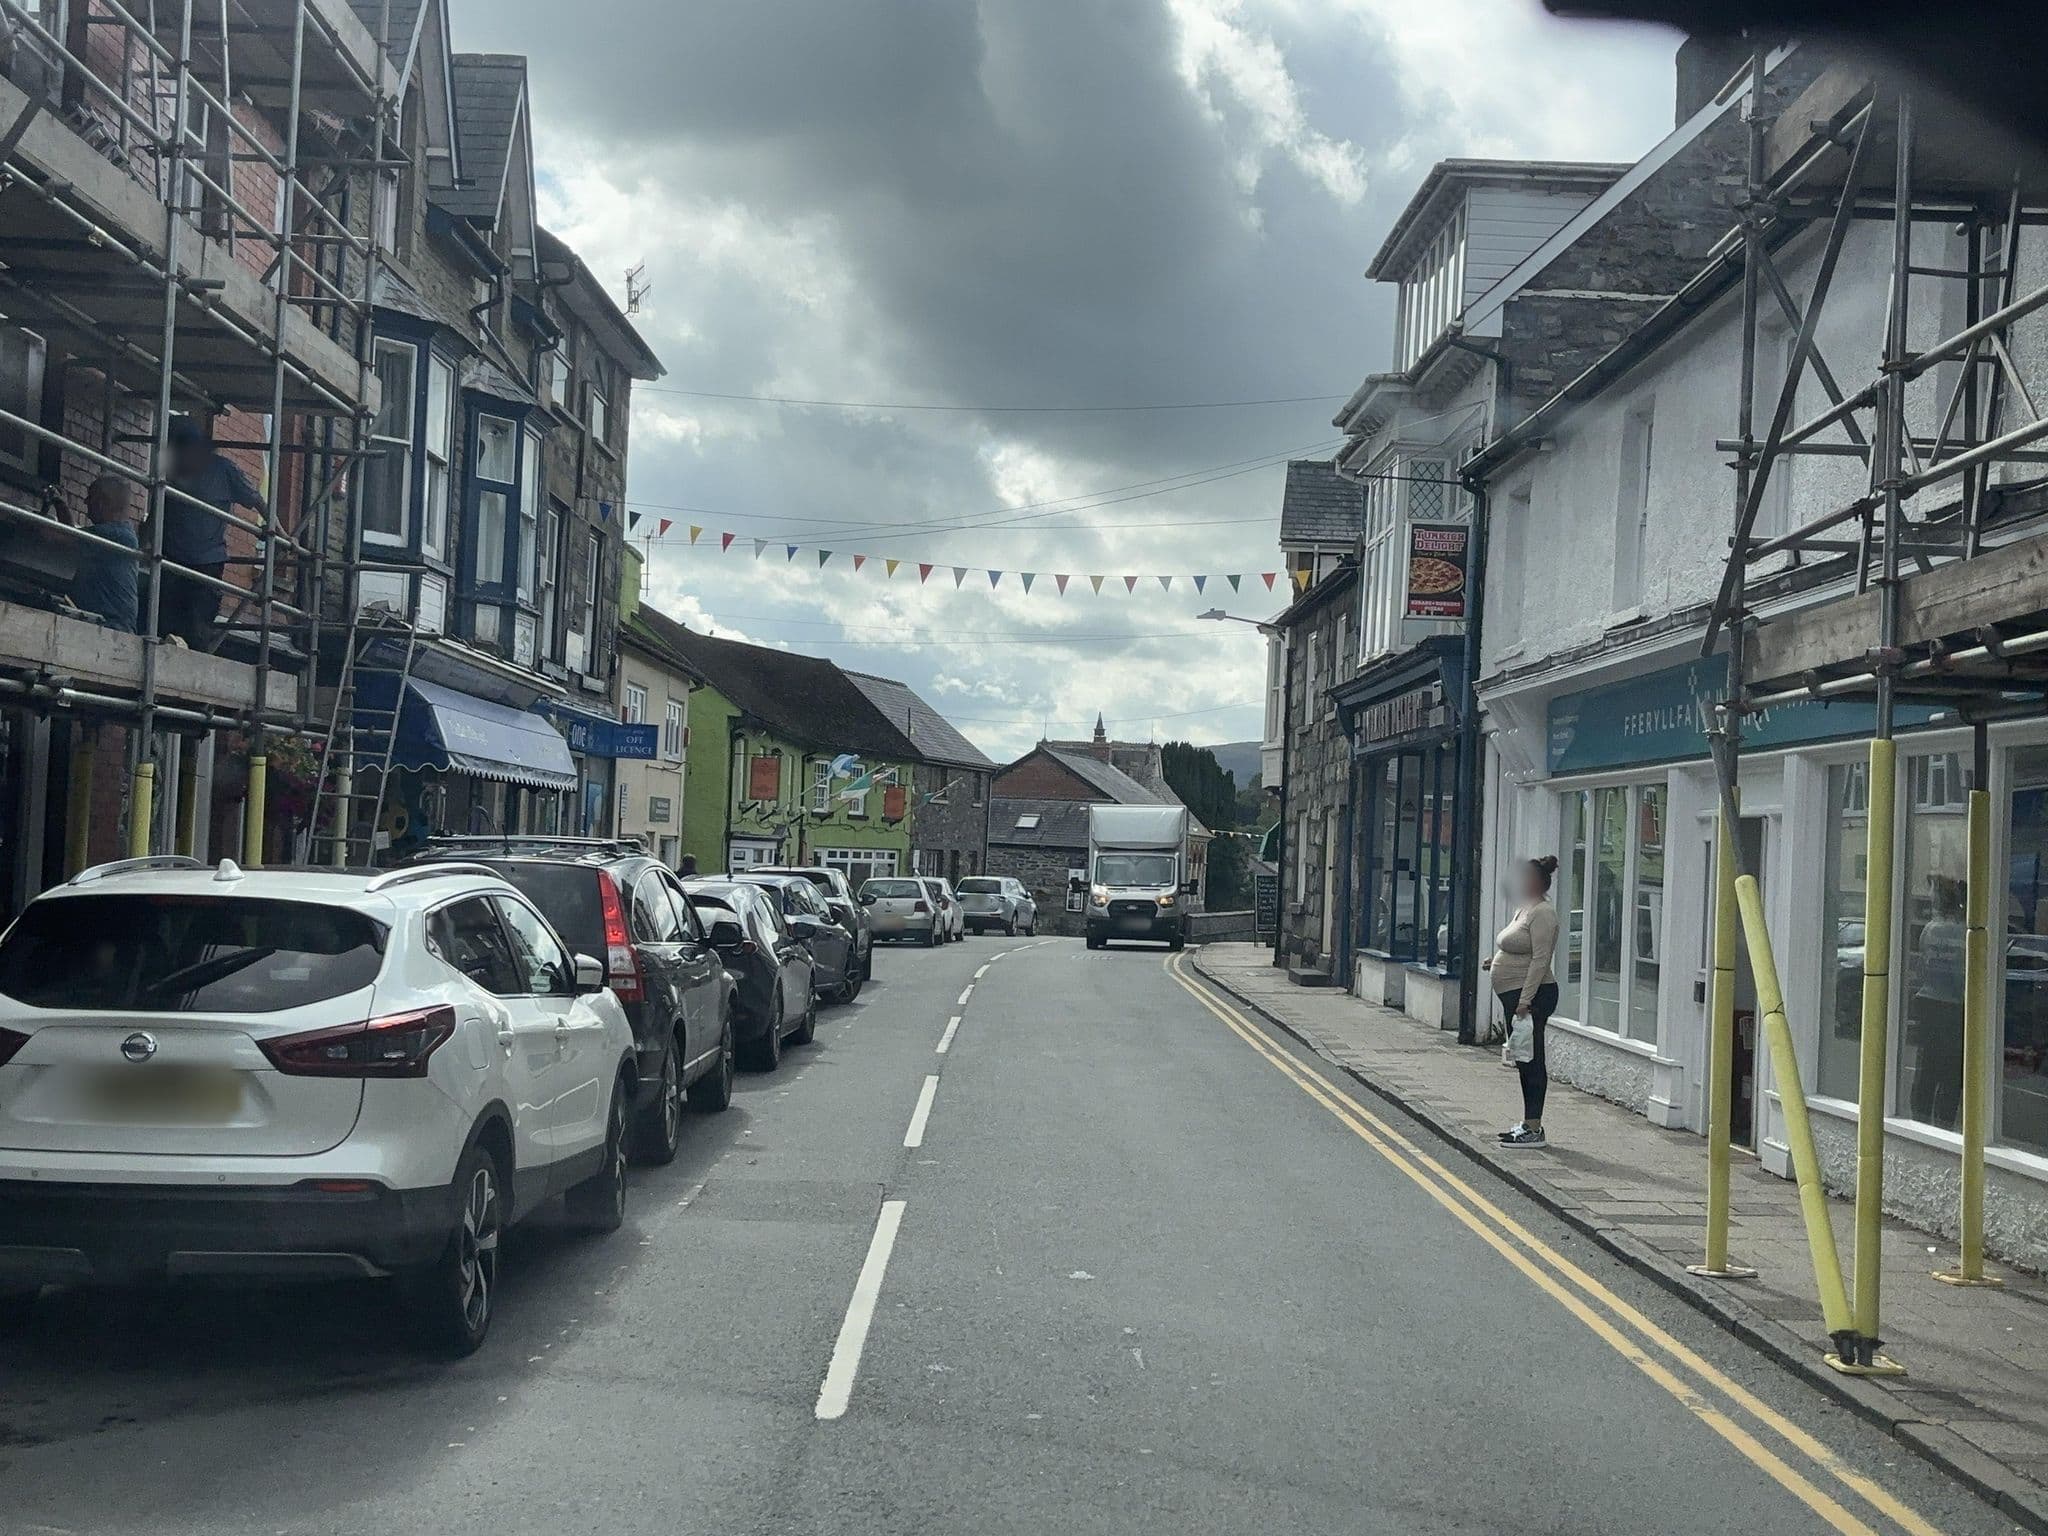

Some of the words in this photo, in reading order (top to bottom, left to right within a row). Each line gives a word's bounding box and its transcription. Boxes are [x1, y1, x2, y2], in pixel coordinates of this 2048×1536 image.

[1414, 529, 1466, 542] TURKISH
[1414, 540, 1464, 551] DELIGHT
[1624, 703, 1692, 737] FFERYLLFA
[625, 735, 644, 744] OFF
[615, 745, 652, 755] LICENCE
